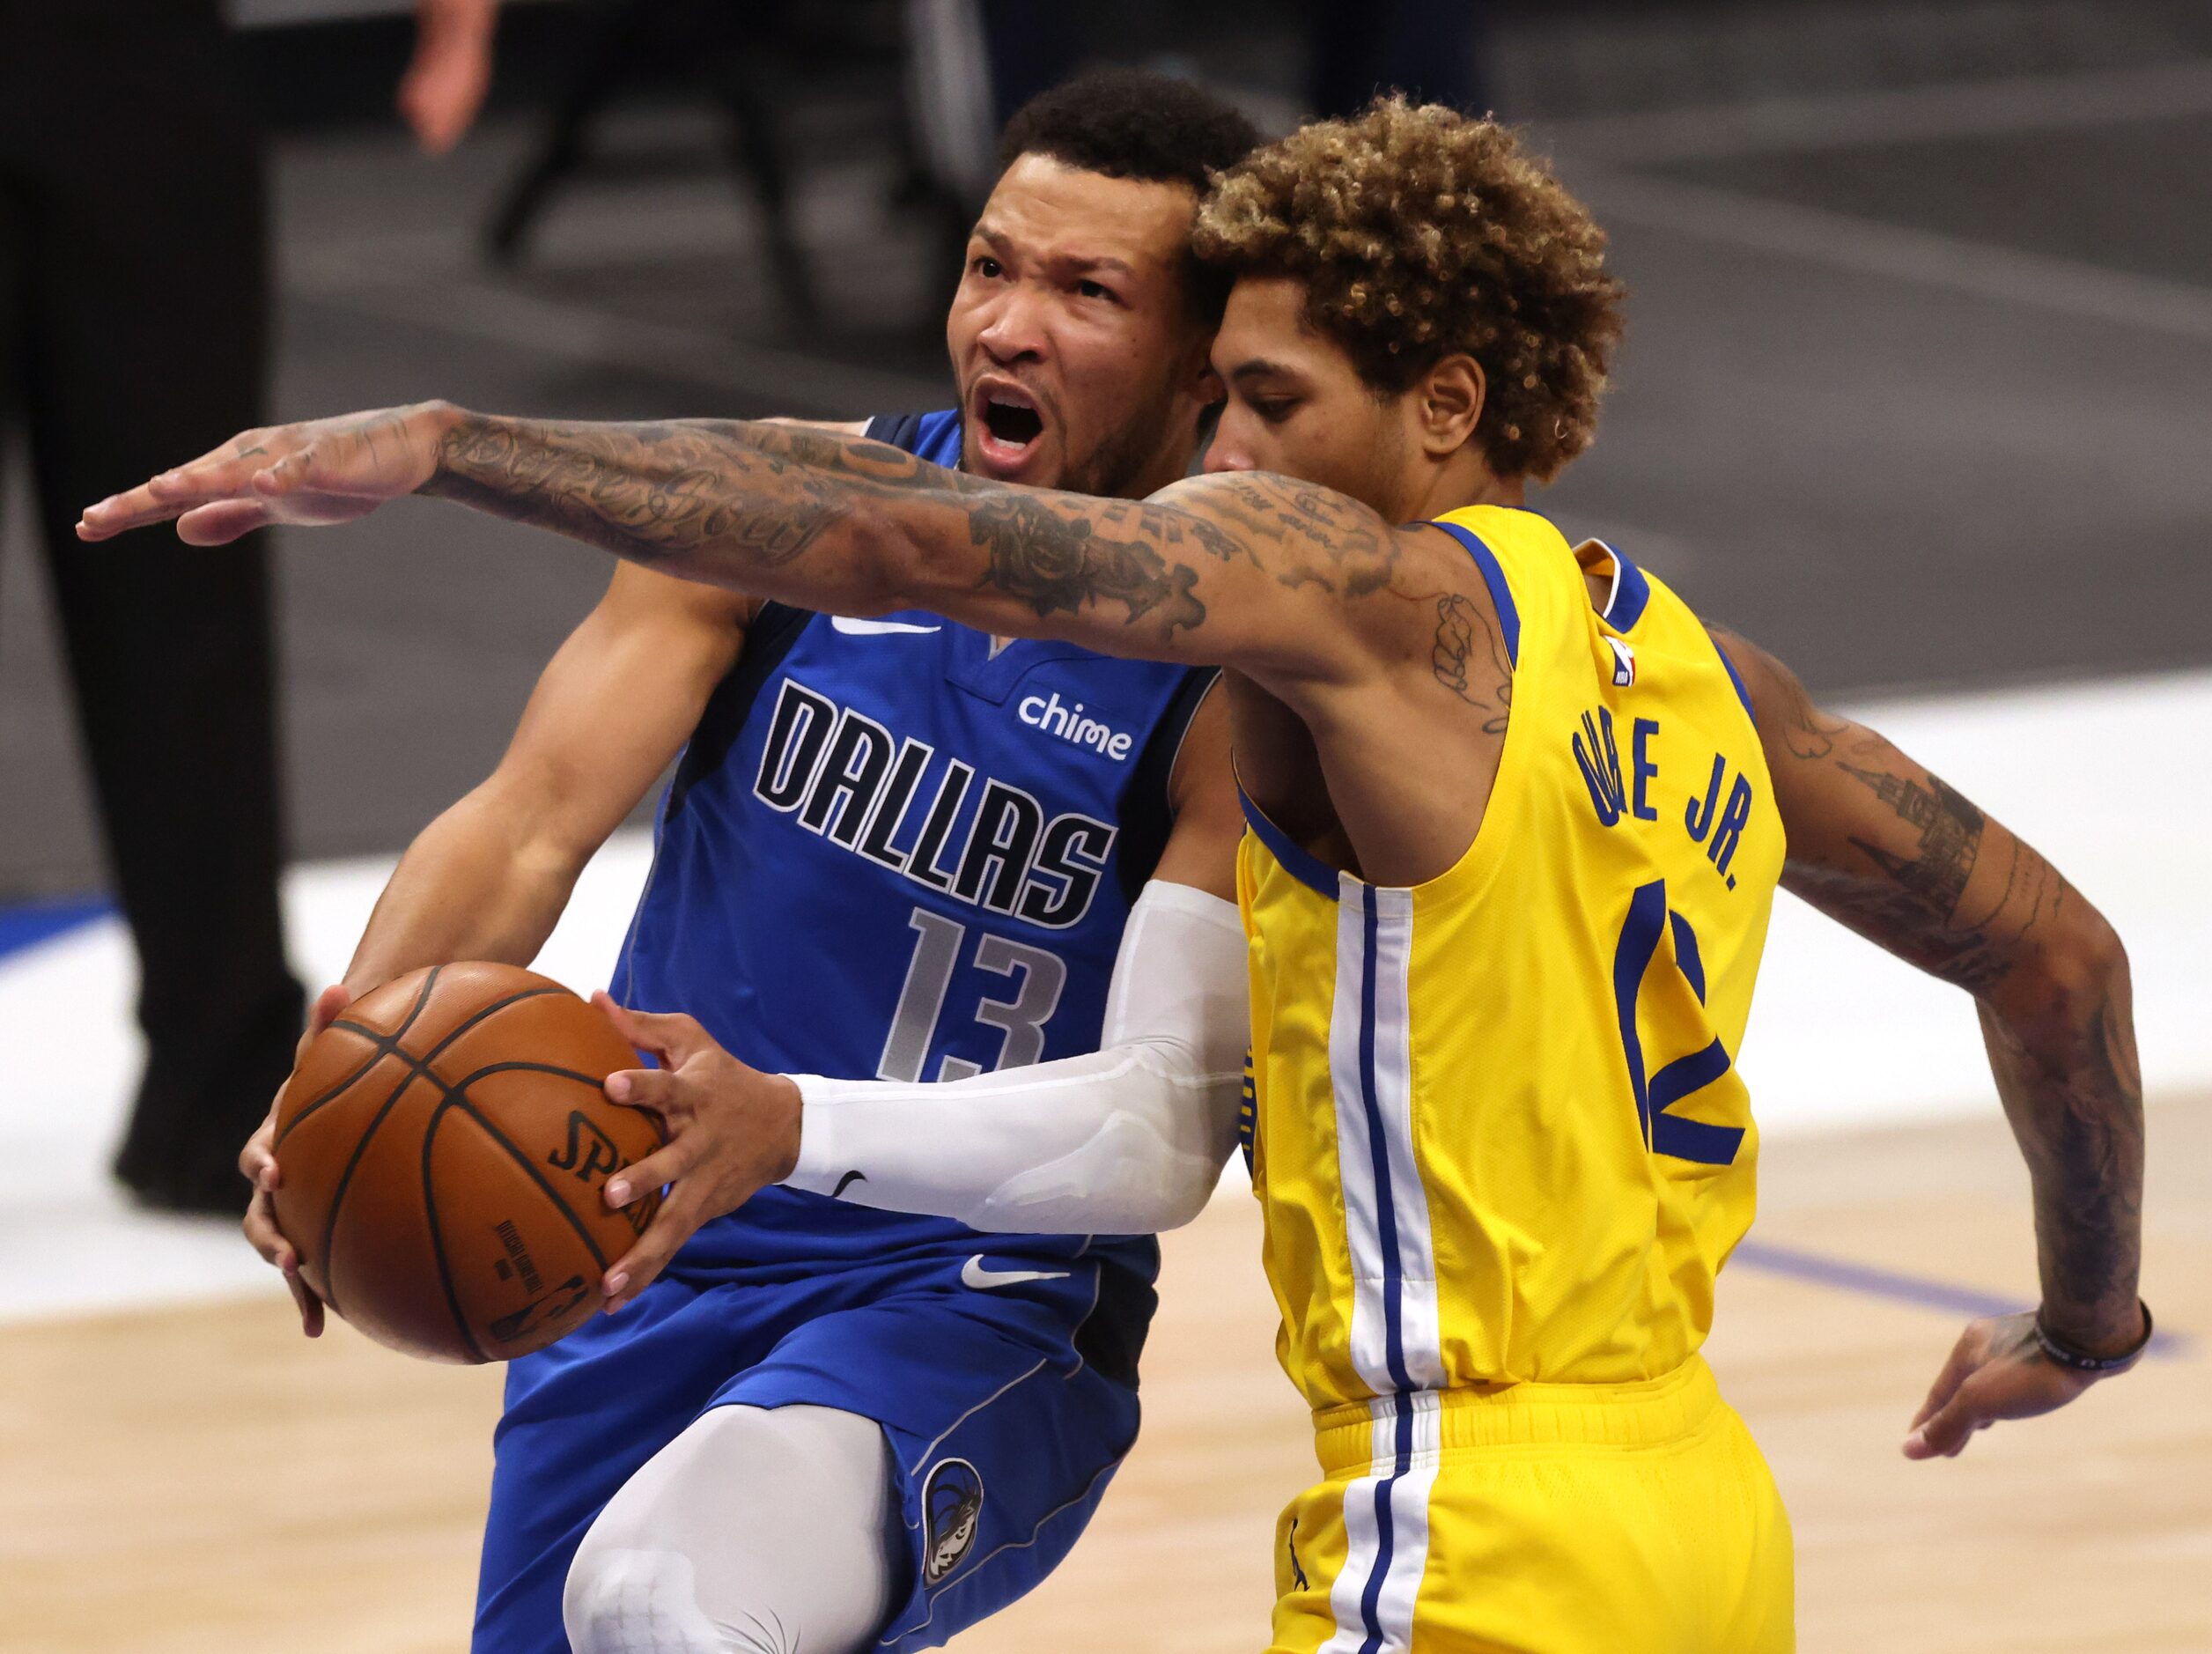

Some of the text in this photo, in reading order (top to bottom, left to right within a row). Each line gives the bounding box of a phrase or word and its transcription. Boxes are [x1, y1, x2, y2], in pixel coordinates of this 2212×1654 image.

[753, 677, 1118, 930] DALLAS
[1018, 692, 1133, 761] chime
[1685, 752, 1752, 891] JR.
[875, 906, 1067, 1084] 13
